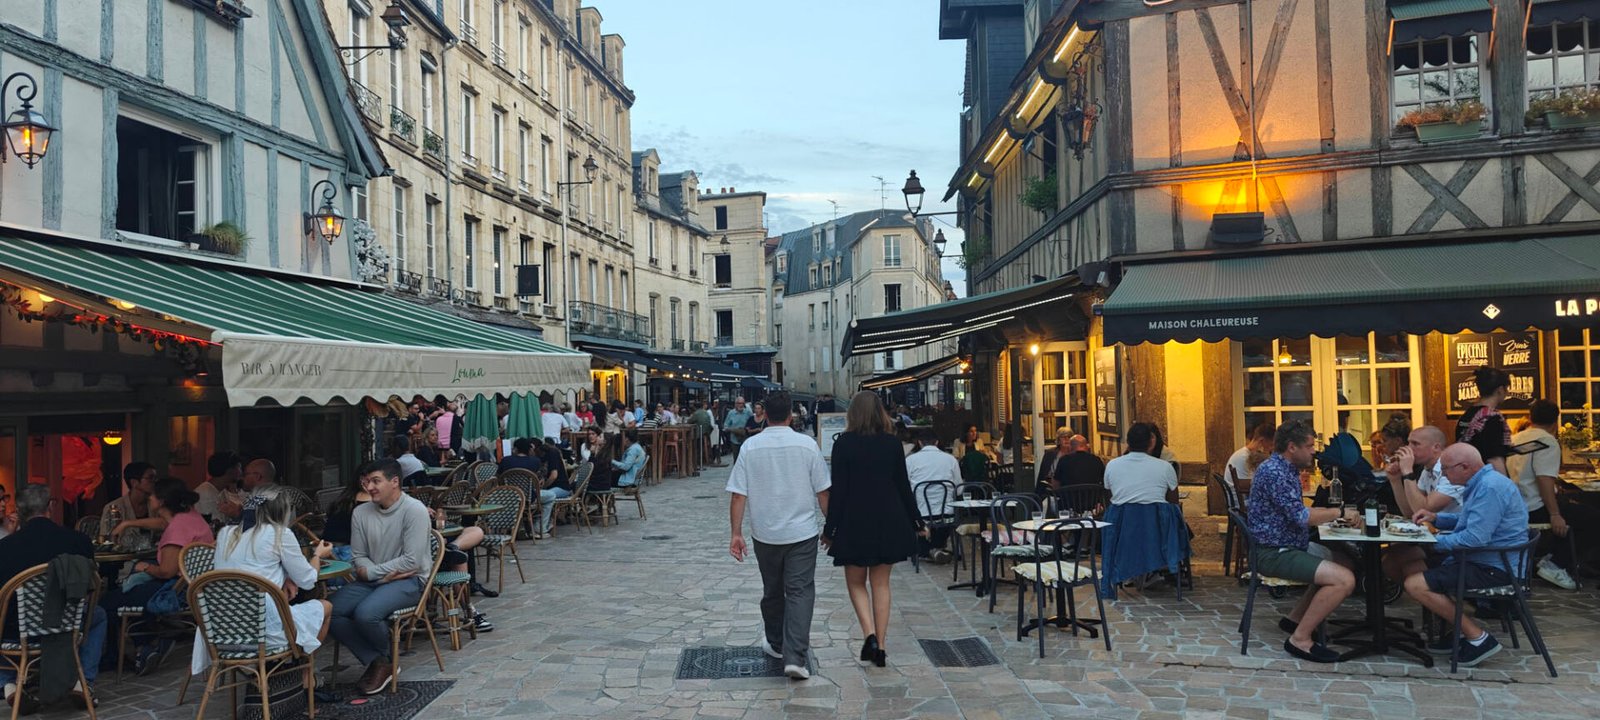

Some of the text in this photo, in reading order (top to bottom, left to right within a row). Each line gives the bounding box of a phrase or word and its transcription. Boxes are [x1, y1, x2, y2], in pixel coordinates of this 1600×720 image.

[1555, 299, 1600, 316] LA P
[1148, 316, 1260, 330] MAISON CHALEUREUSE
[1503, 351, 1531, 366] VERRE
[241, 361, 263, 375] BAR
[1458, 380, 1477, 388] COCK
[1507, 374, 1534, 393] ÈRES
